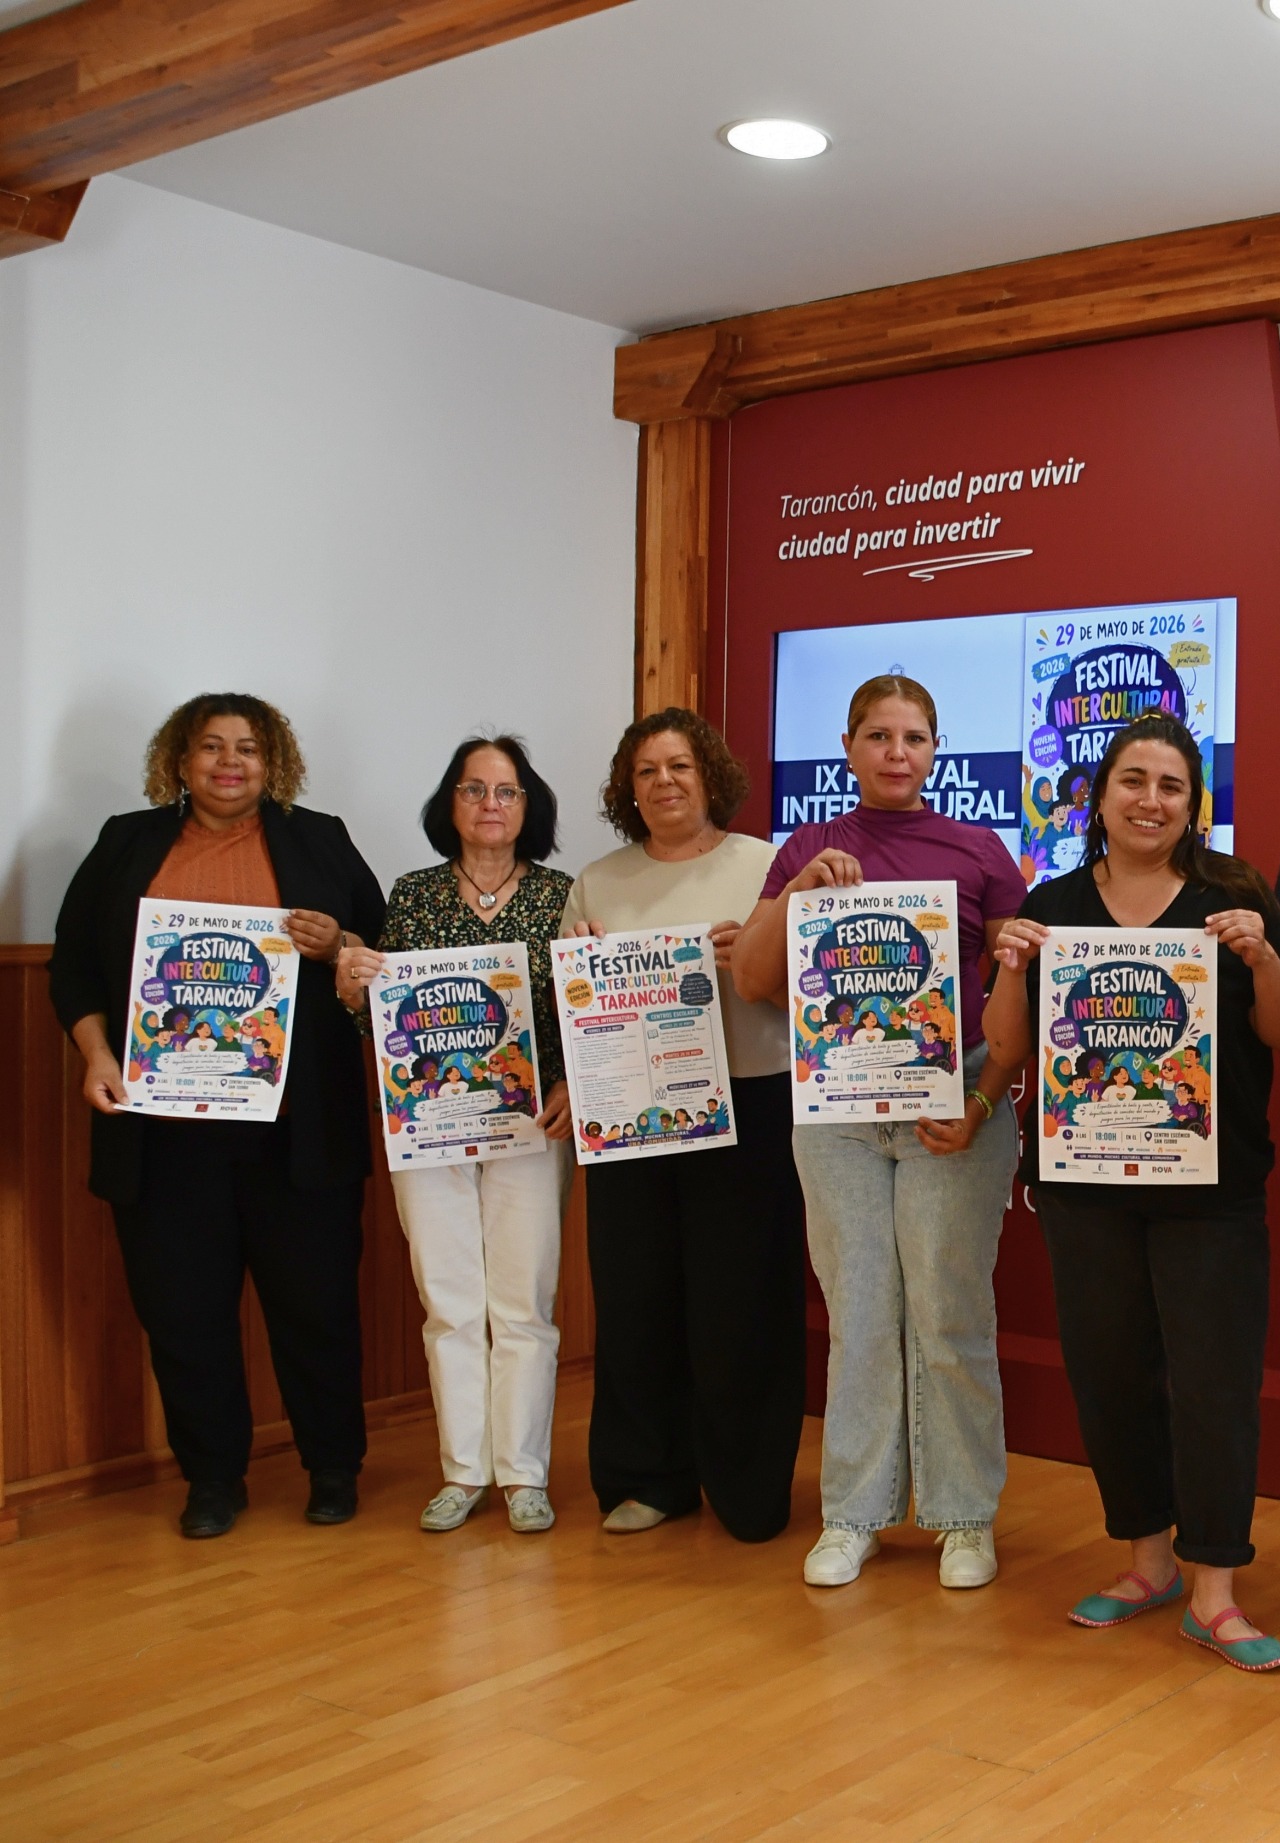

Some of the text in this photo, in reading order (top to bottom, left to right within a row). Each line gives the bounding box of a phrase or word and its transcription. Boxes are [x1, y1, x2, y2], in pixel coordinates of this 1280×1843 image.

[780, 457, 1085, 518] Tarancón, ciudad para vivir
[778, 512, 1001, 560] ciudad para invertir
[1056, 614, 1185, 646] 29 DE MAYO DE 2026
[1040, 659, 1064, 677] 2026
[1075, 652, 1162, 693] FESTIVAL
[1033, 732, 1056, 746] NOVENA
[1034, 743, 1057, 758] EDICIÓN
[815, 759, 979, 793] IX FVAL
[818, 895, 927, 913] 29 DE MAYO DE 2026
[168, 914, 274, 932] 29 DE MAYO DE 2026
[805, 921, 827, 933] 2026
[836, 918, 910, 945] FESTIVAL
[153, 935, 175, 945] 2026
[617, 941, 642, 954] 2026
[182, 938, 253, 962] FESTIVAL
[820, 944, 926, 970] INTERCULTURAL
[1073, 942, 1186, 958] 29 DE MAYO DE 2026
[163, 961, 265, 985] INTERCULTURAL
[397, 957, 500, 979] 29 DE MAYO DE 2026
[589, 950, 675, 978] FESTIVAL
[595, 972, 679, 992] INTERCULTURAL
[802, 974, 823, 983] NOVENA
[831, 968, 918, 995] TARANCÓN
[1059, 969, 1081, 980] 2026
[1090, 967, 1166, 996] FESTIVAL
[172, 980, 256, 1008] TARANCÓN
[386, 988, 407, 1000] 2026
[568, 984, 588, 995] NOVENA
[804, 980, 824, 990] EDICIÓN
[416, 981, 486, 1009] FESTIVAL
[570, 991, 590, 1002] EDICIÓN
[597, 987, 678, 1012] TARANCÓN
[402, 1002, 502, 1032] INTERCULTURAL
[651, 1009, 699, 1020] CENTROS ESCOLARES
[1072, 996, 1182, 1021] INTERCULTURAL
[579, 1014, 637, 1026] FESTIVAL INTERCULTURAL
[1054, 1024, 1074, 1033] NOVENA
[415, 1025, 496, 1053] TARANCÓN
[1054, 1031, 1075, 1041] EDICIÓN
[1083, 1020, 1173, 1048] TARANCÓN
[1095, 1131, 1116, 1141] 18:00H
[1152, 1166, 1172, 1174] ROVA
